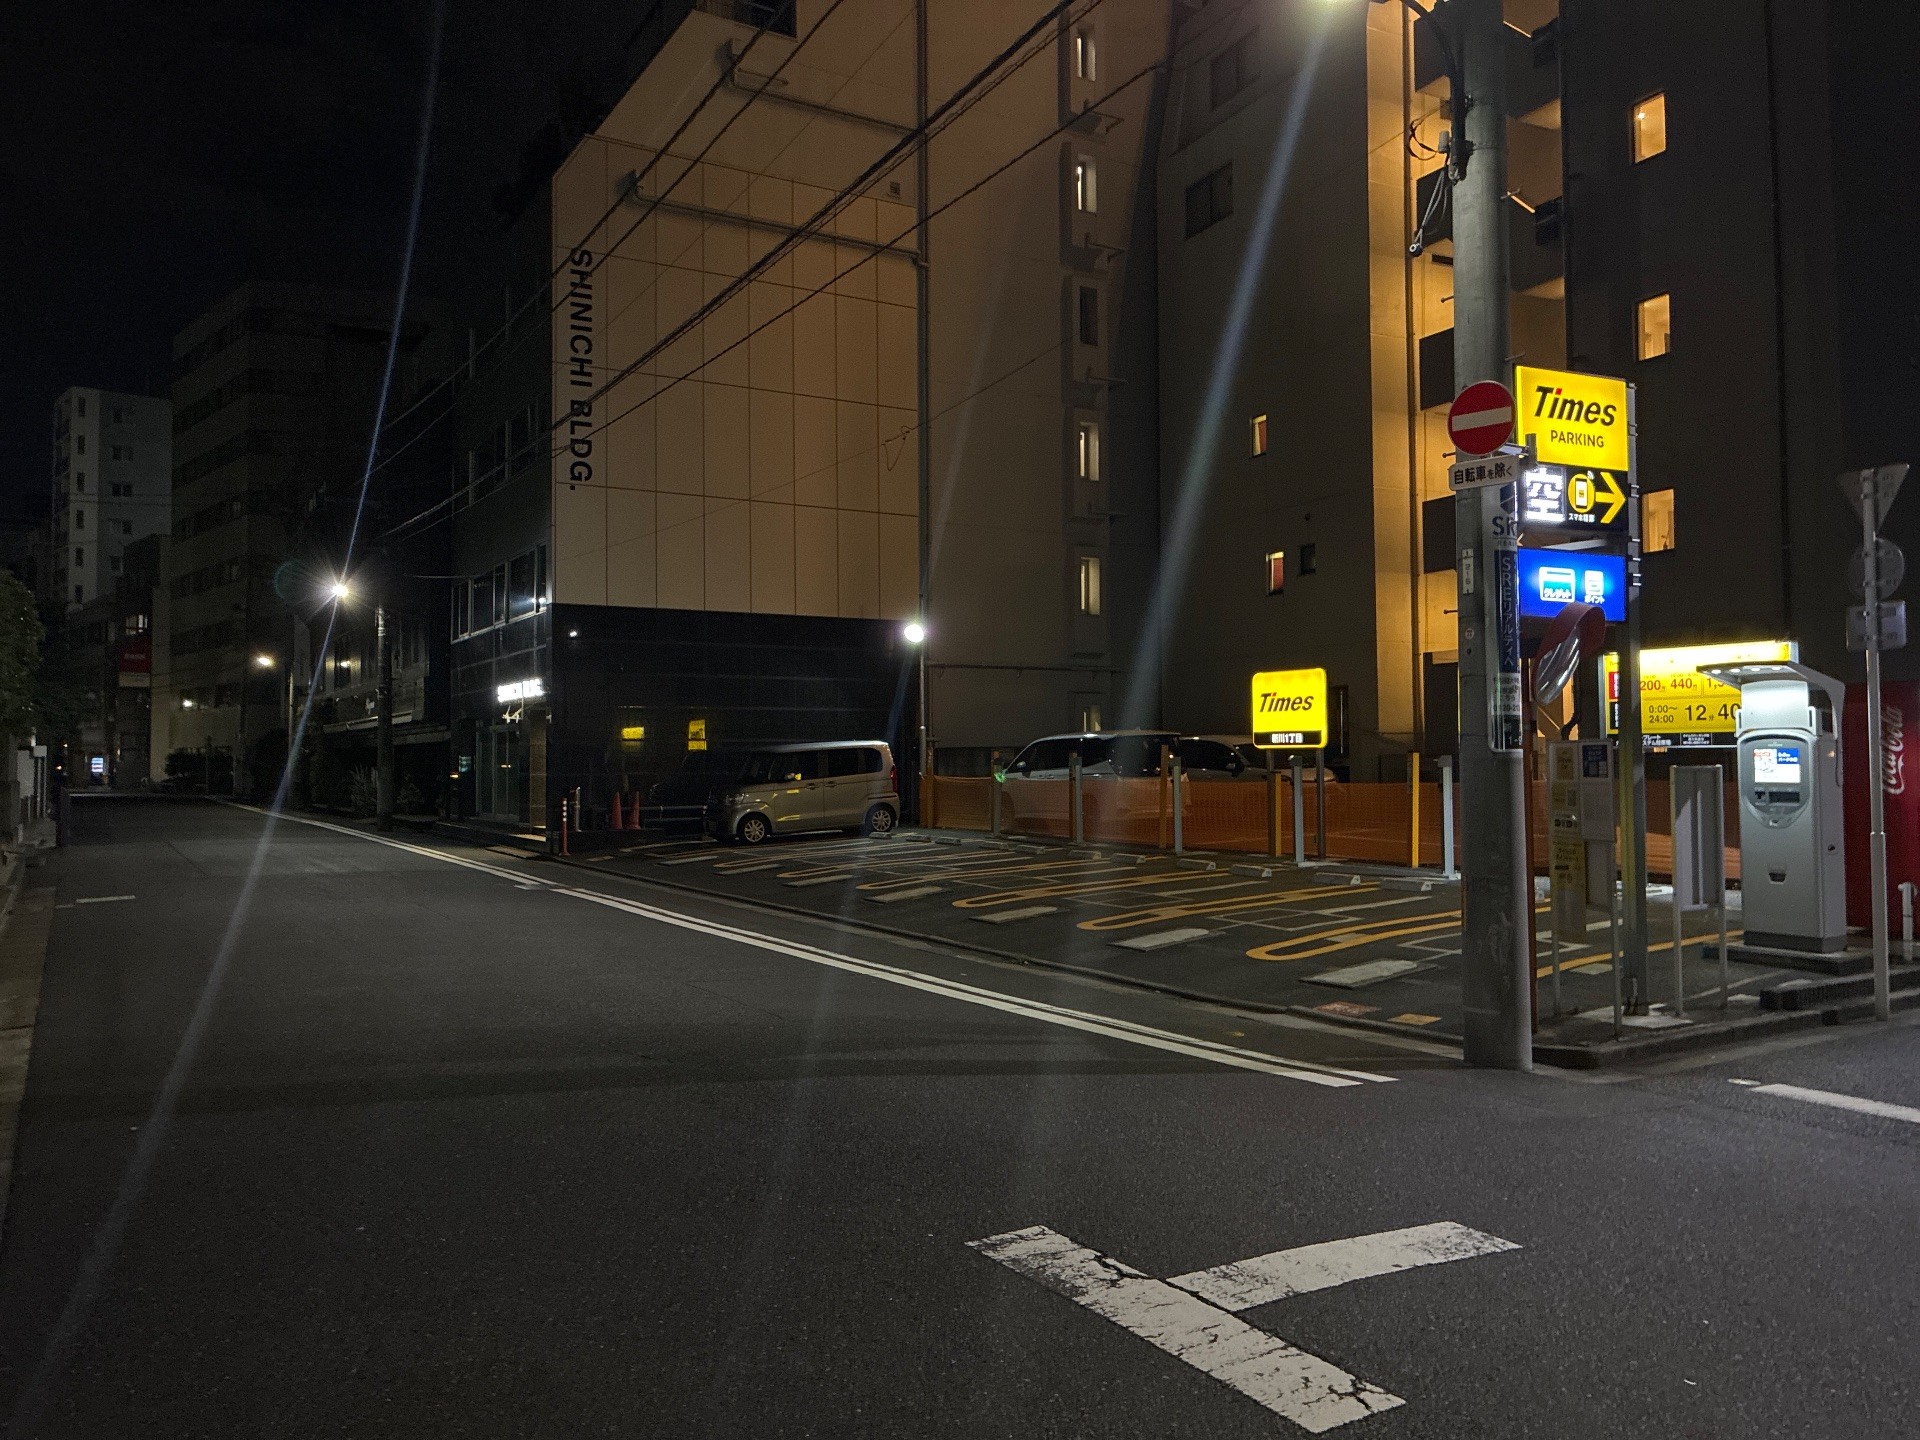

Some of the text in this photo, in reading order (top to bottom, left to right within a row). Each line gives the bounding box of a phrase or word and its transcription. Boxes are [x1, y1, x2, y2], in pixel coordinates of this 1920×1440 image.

[570, 249, 592, 491] SHINICHI BLDG.
[1534, 385, 1617, 426] Times
[1550, 429, 1604, 448] PARKING
[1453, 463, 1512, 485] 自転車を除く
[1526, 467, 1565, 522] 空
[1260, 692, 1314, 713] Times
[1648, 714, 1674, 724] 24:00
